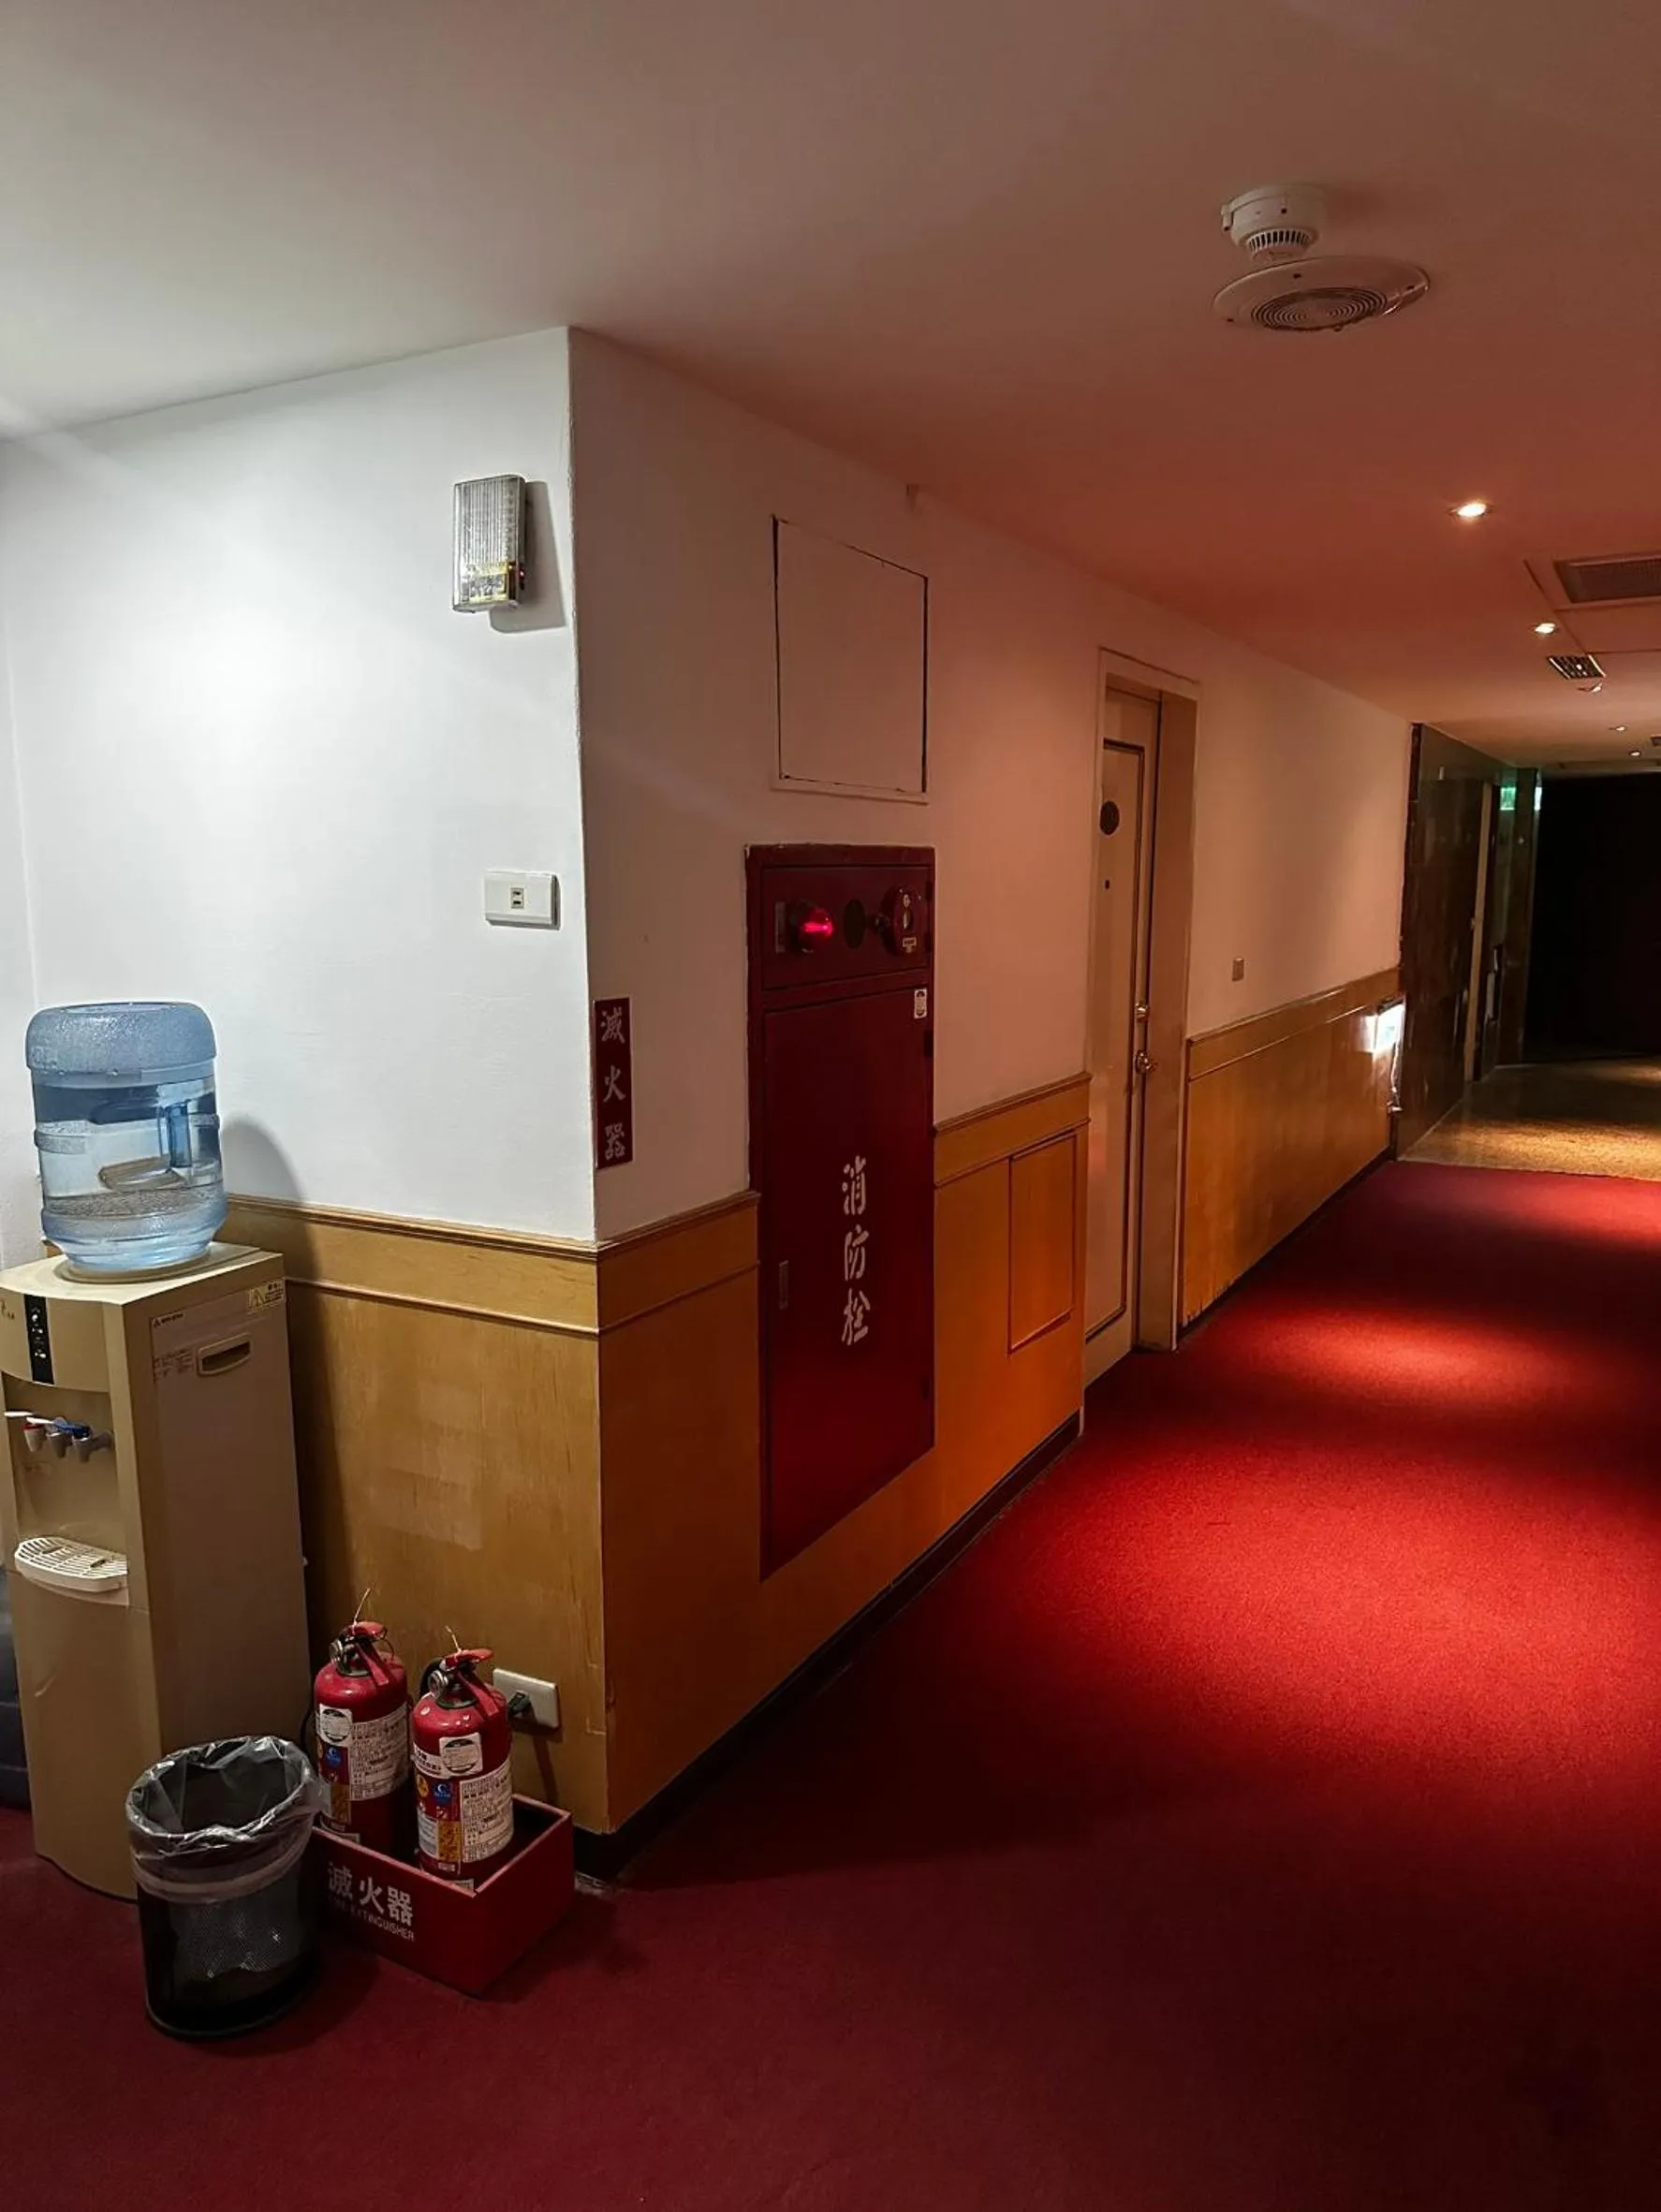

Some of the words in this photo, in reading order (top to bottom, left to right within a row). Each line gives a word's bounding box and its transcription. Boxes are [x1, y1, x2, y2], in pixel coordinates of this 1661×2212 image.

[600, 1006, 626, 1160] 滅火器
[842, 1155, 871, 1346] 消防栓
[327, 1861, 414, 1926] 滅火器
